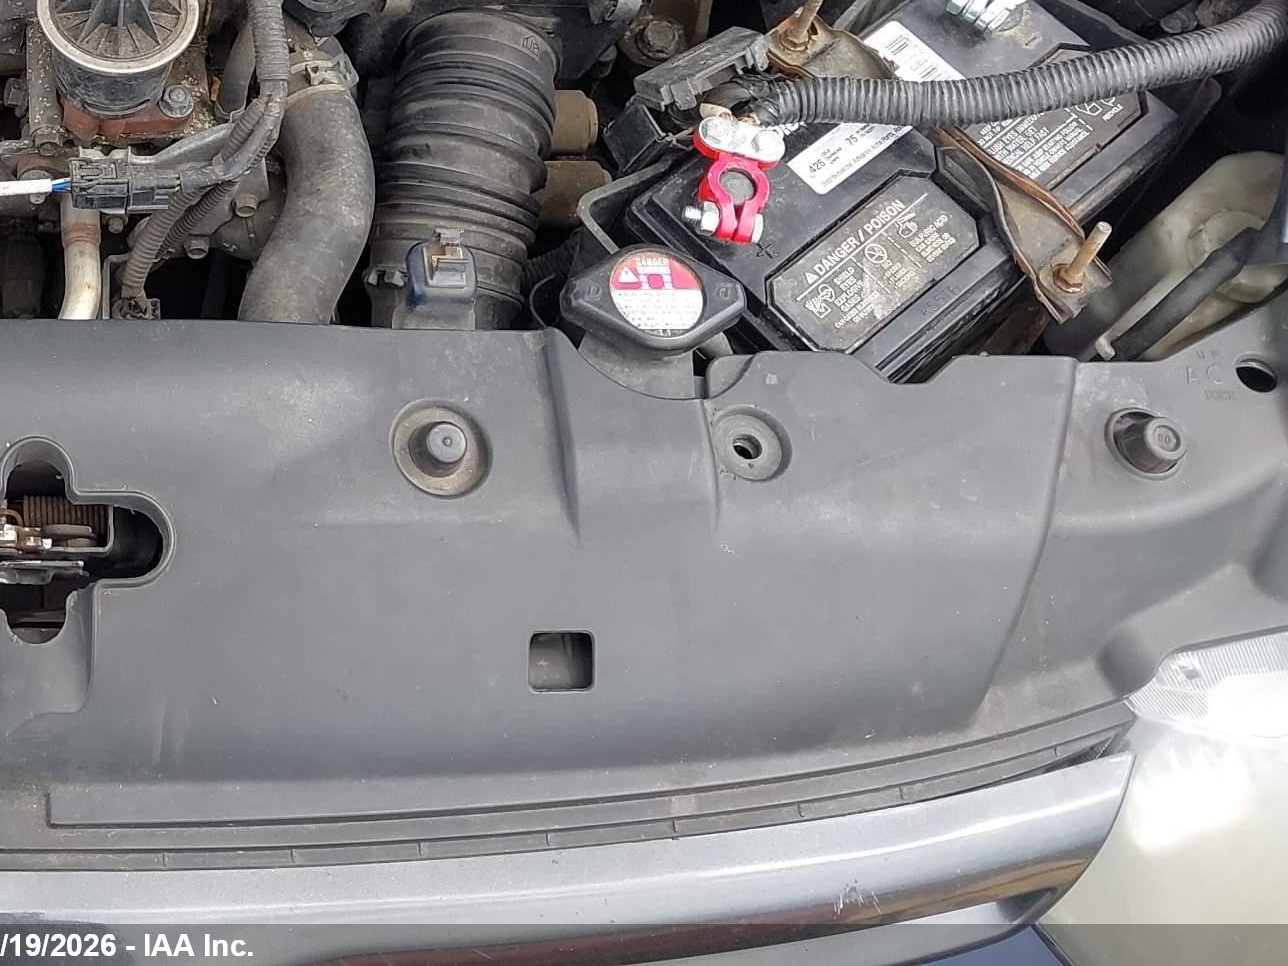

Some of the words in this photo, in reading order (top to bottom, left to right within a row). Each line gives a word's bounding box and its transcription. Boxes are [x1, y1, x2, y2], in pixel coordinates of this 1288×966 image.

[845, 133, 857, 146] 75
[814, 236, 859, 276] DANGER
[864, 198, 905, 235] POISON
